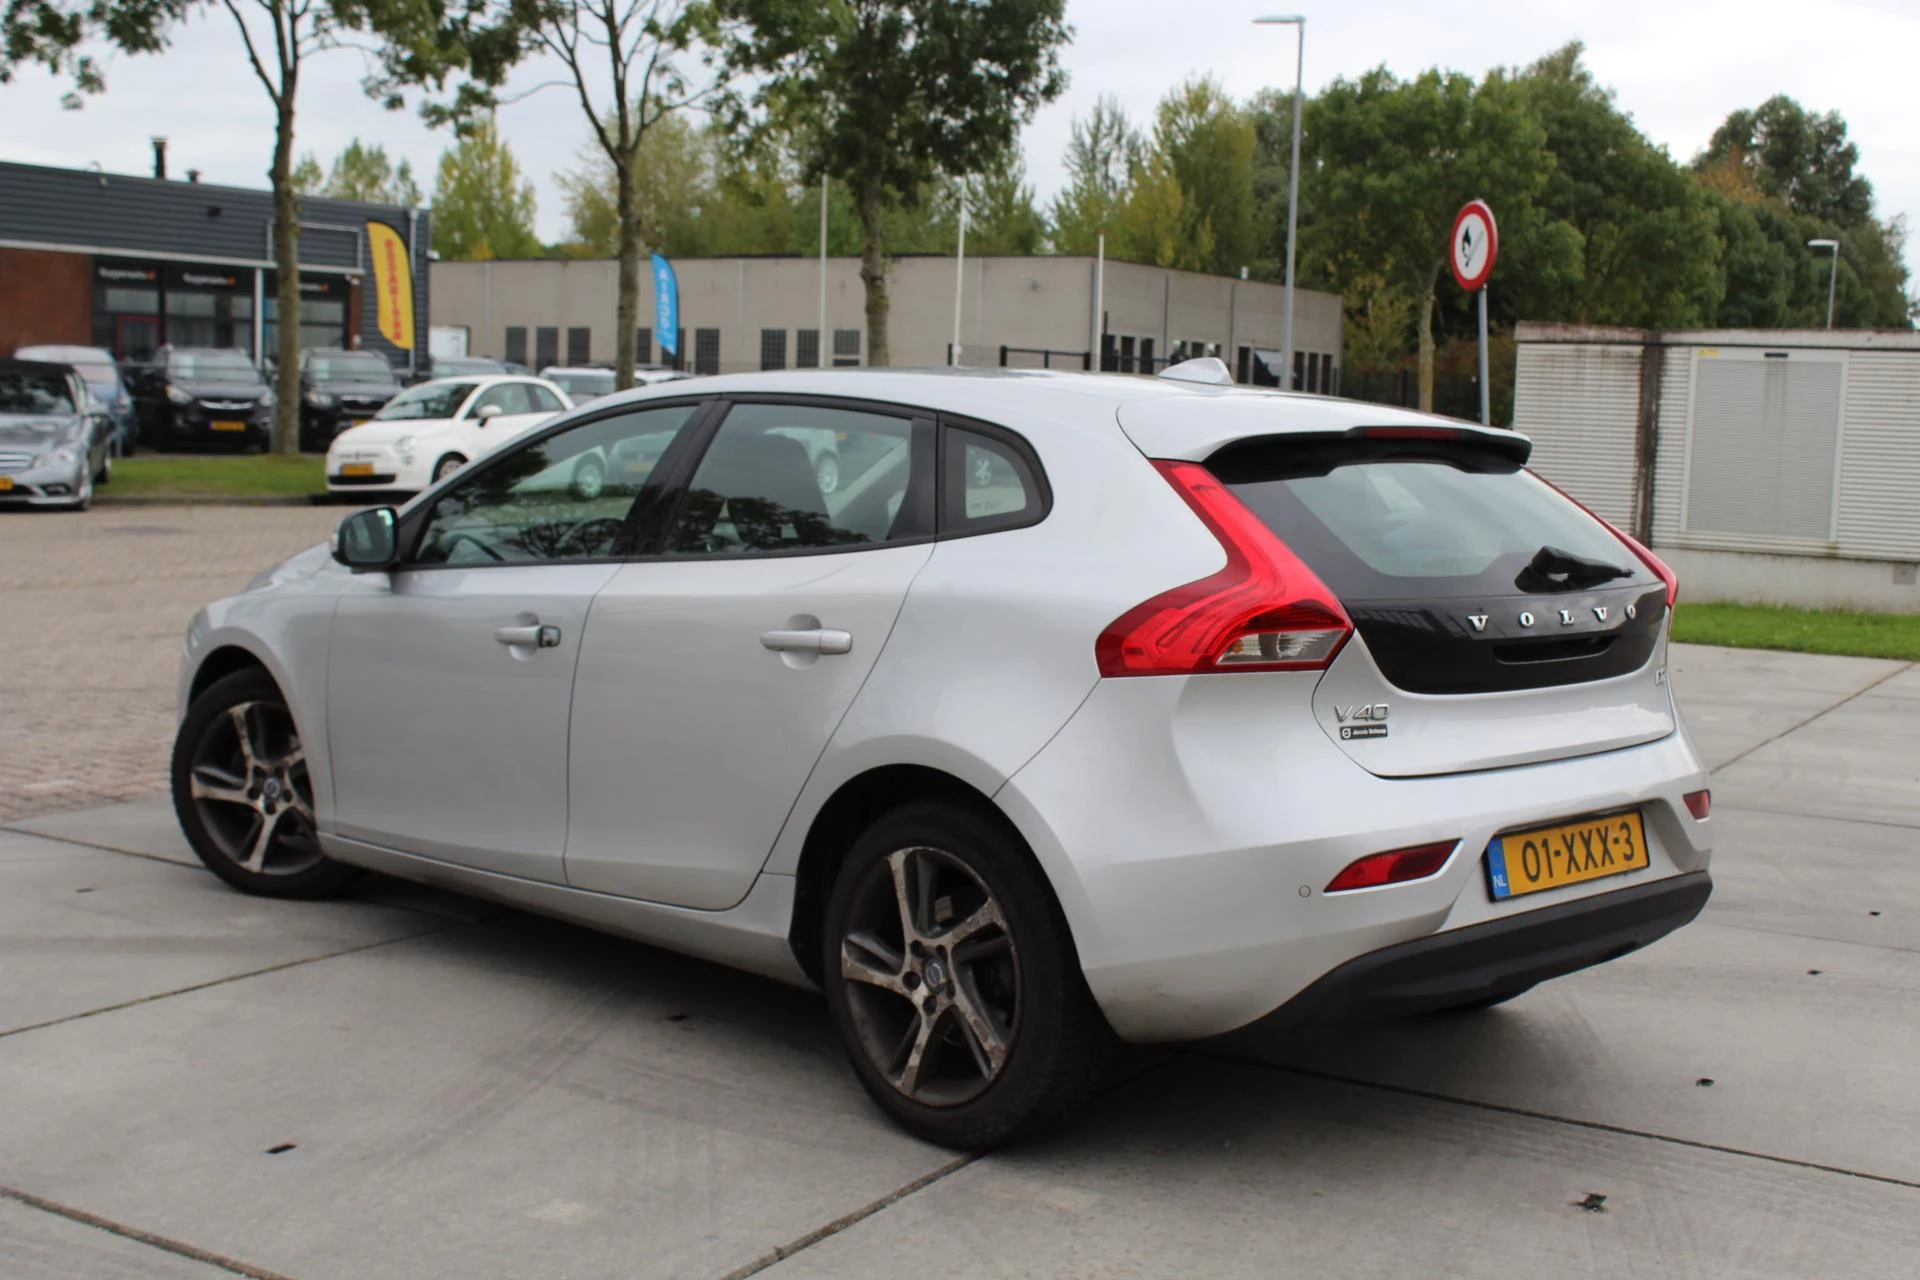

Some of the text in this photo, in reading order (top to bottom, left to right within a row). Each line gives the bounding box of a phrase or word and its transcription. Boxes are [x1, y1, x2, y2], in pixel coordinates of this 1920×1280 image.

[1468, 604, 1636, 632] VOLVO
[1334, 704, 1390, 723] V40
[1521, 821, 1635, 883] 01-XXX-3
[1493, 874, 1507, 889] NL
